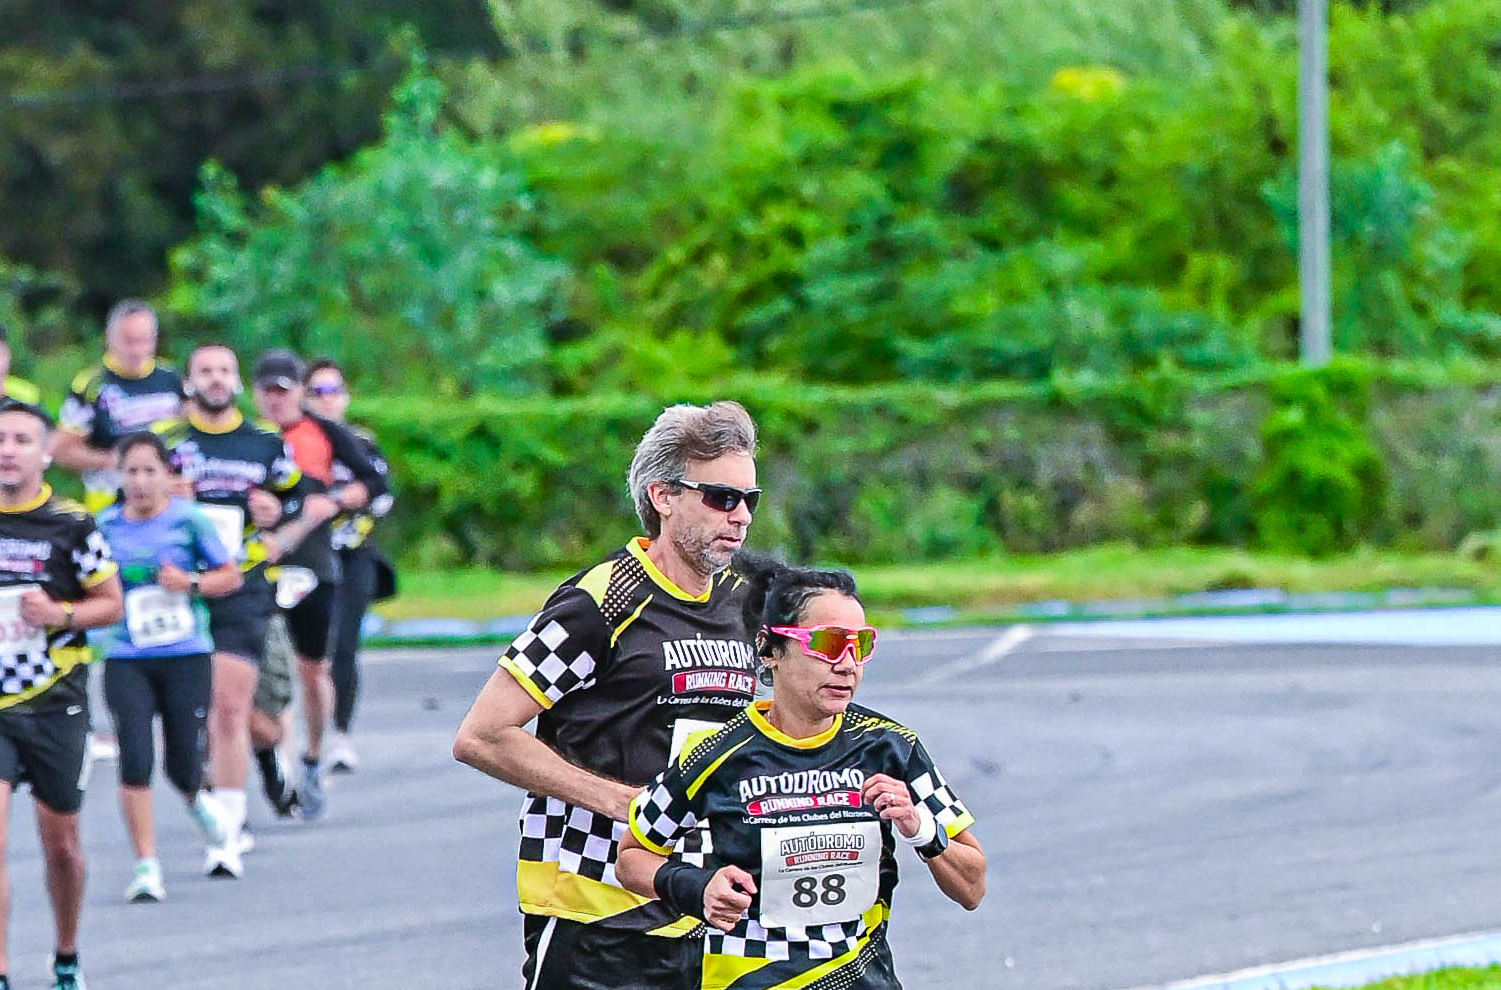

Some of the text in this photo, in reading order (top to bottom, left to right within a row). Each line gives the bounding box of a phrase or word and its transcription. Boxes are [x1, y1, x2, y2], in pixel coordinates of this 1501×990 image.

[662, 632, 755, 671] AUTÓDROM
[685, 671, 754, 693] RUNNING RACE
[738, 767, 865, 803] AUTÓDROMO
[816, 792, 850, 806] RACE
[778, 815, 788, 824] de
[789, 814, 801, 823] los
[802, 812, 828, 822] Clubes
[829, 811, 842, 820] del
[780, 830, 866, 857] AUTÓDROMO
[830, 850, 851, 861] RACE
[792, 874, 847, 908] 88
